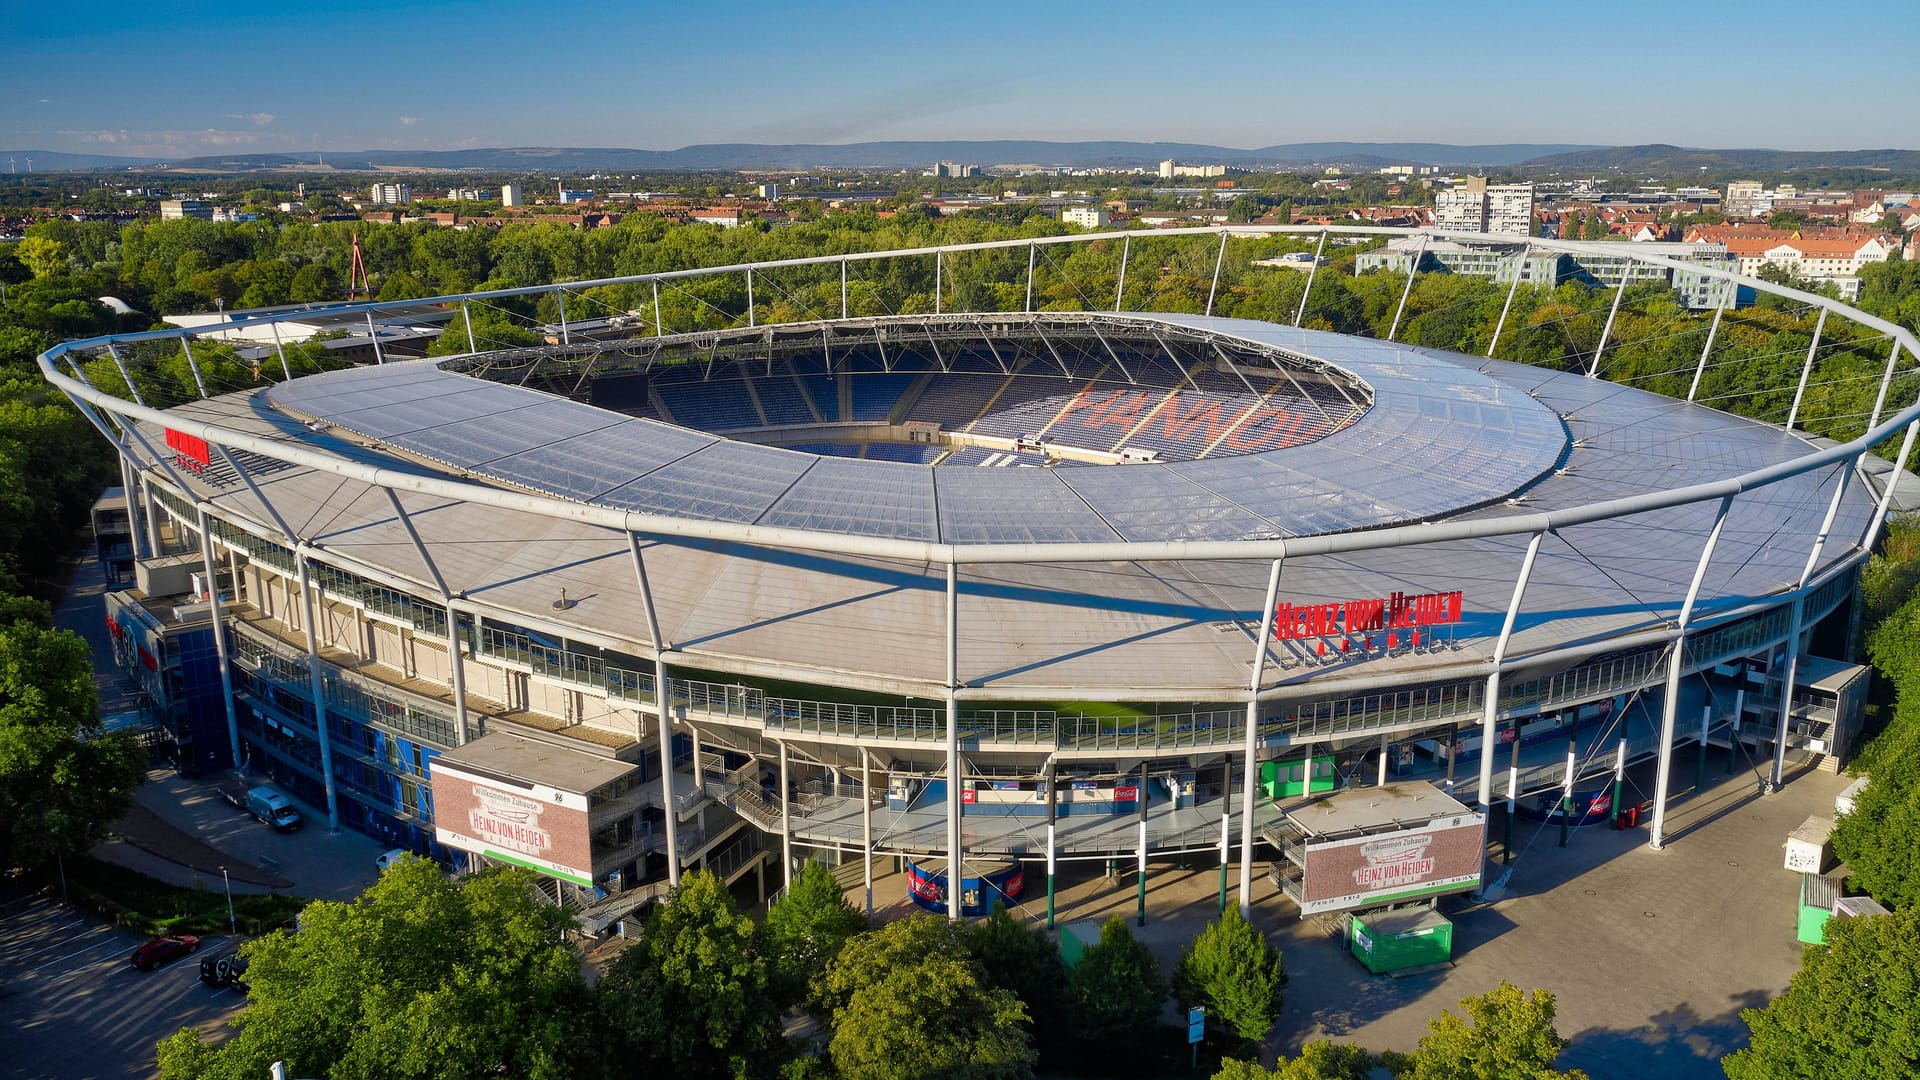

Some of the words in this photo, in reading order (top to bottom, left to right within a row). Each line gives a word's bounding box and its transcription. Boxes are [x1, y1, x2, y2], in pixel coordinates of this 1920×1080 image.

[1277, 602, 1340, 640] HEINZ
[1344, 599, 1384, 634] VON
[1389, 591, 1462, 629] HEIDEN
[475, 786, 510, 804] Willkommen
[512, 797, 537, 810] Zuhause
[473, 812, 496, 834] HEINZ
[498, 822, 513, 840] VON
[515, 824, 544, 848] HEIDEN
[1365, 841, 1401, 852] Willkommen
[1403, 837, 1428, 846] Zuhause
[1358, 867, 1381, 883] HEINZ
[1384, 864, 1400, 879] VON
[1402, 859, 1431, 876] HEIDEN
